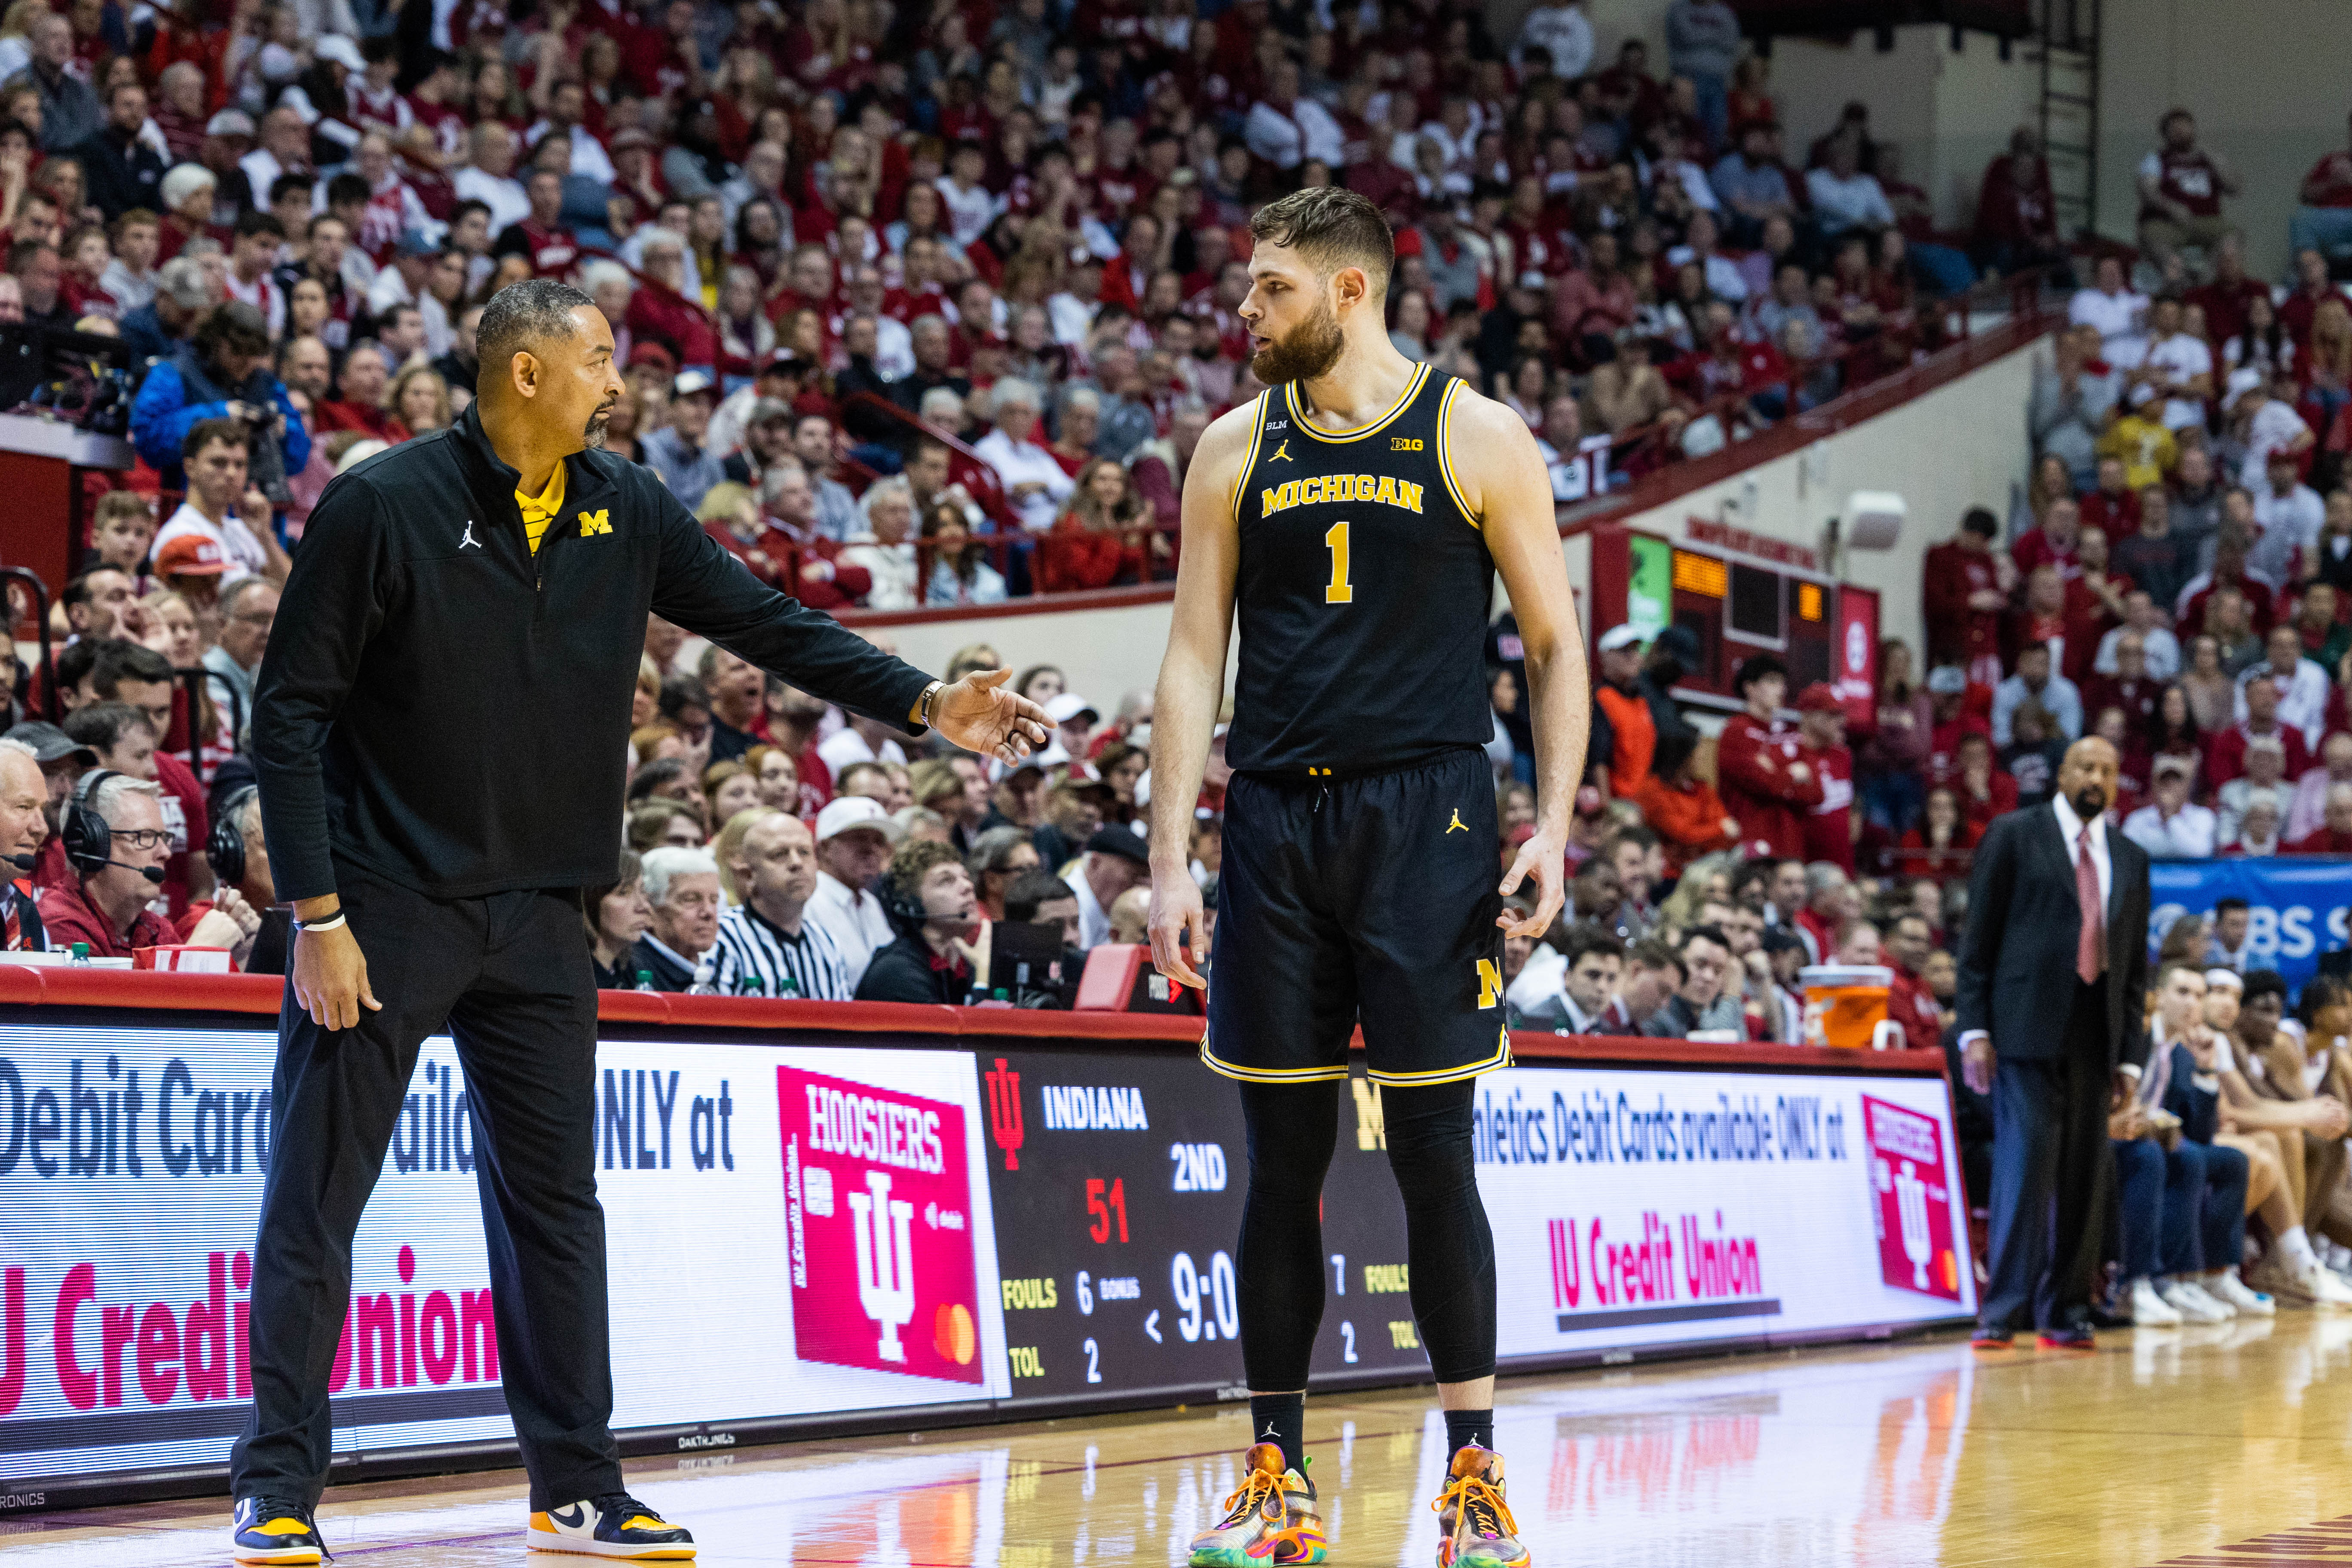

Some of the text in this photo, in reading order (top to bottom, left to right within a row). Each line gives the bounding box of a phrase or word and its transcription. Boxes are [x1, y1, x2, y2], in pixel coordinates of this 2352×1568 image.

[1266, 420, 1288, 431] BLM
[1262, 474, 1424, 518] MICHIGAN
[578, 508, 613, 537] M
[1325, 521, 1353, 604] 1
[0, 1053, 143, 1178] Debit
[159, 1058, 271, 1177] Car
[594, 1069, 679, 1170] NLY
[691, 1078, 734, 1172] at
[805, 1084, 943, 1174] HOOSIERS
[1043, 1086, 1149, 1130] INDIANA
[1473, 1086, 1846, 1163] letics Debit Cards available ONLY at
[1170, 1142, 1227, 1191] 2ND
[1087, 1178, 1129, 1243] 51
[1549, 1210, 1761, 1308] IU Credit Union
[1002, 1278, 1057, 1310] FOULS
[1076, 1271, 1094, 1315] 6
[1172, 1250, 1239, 1342] 9:0
[54, 1251, 253, 1410] Credi
[1341, 1321, 1358, 1363] 2
[1009, 1338, 1102, 1383] TOL 2
[0, 1493, 45, 1508] RONICS
